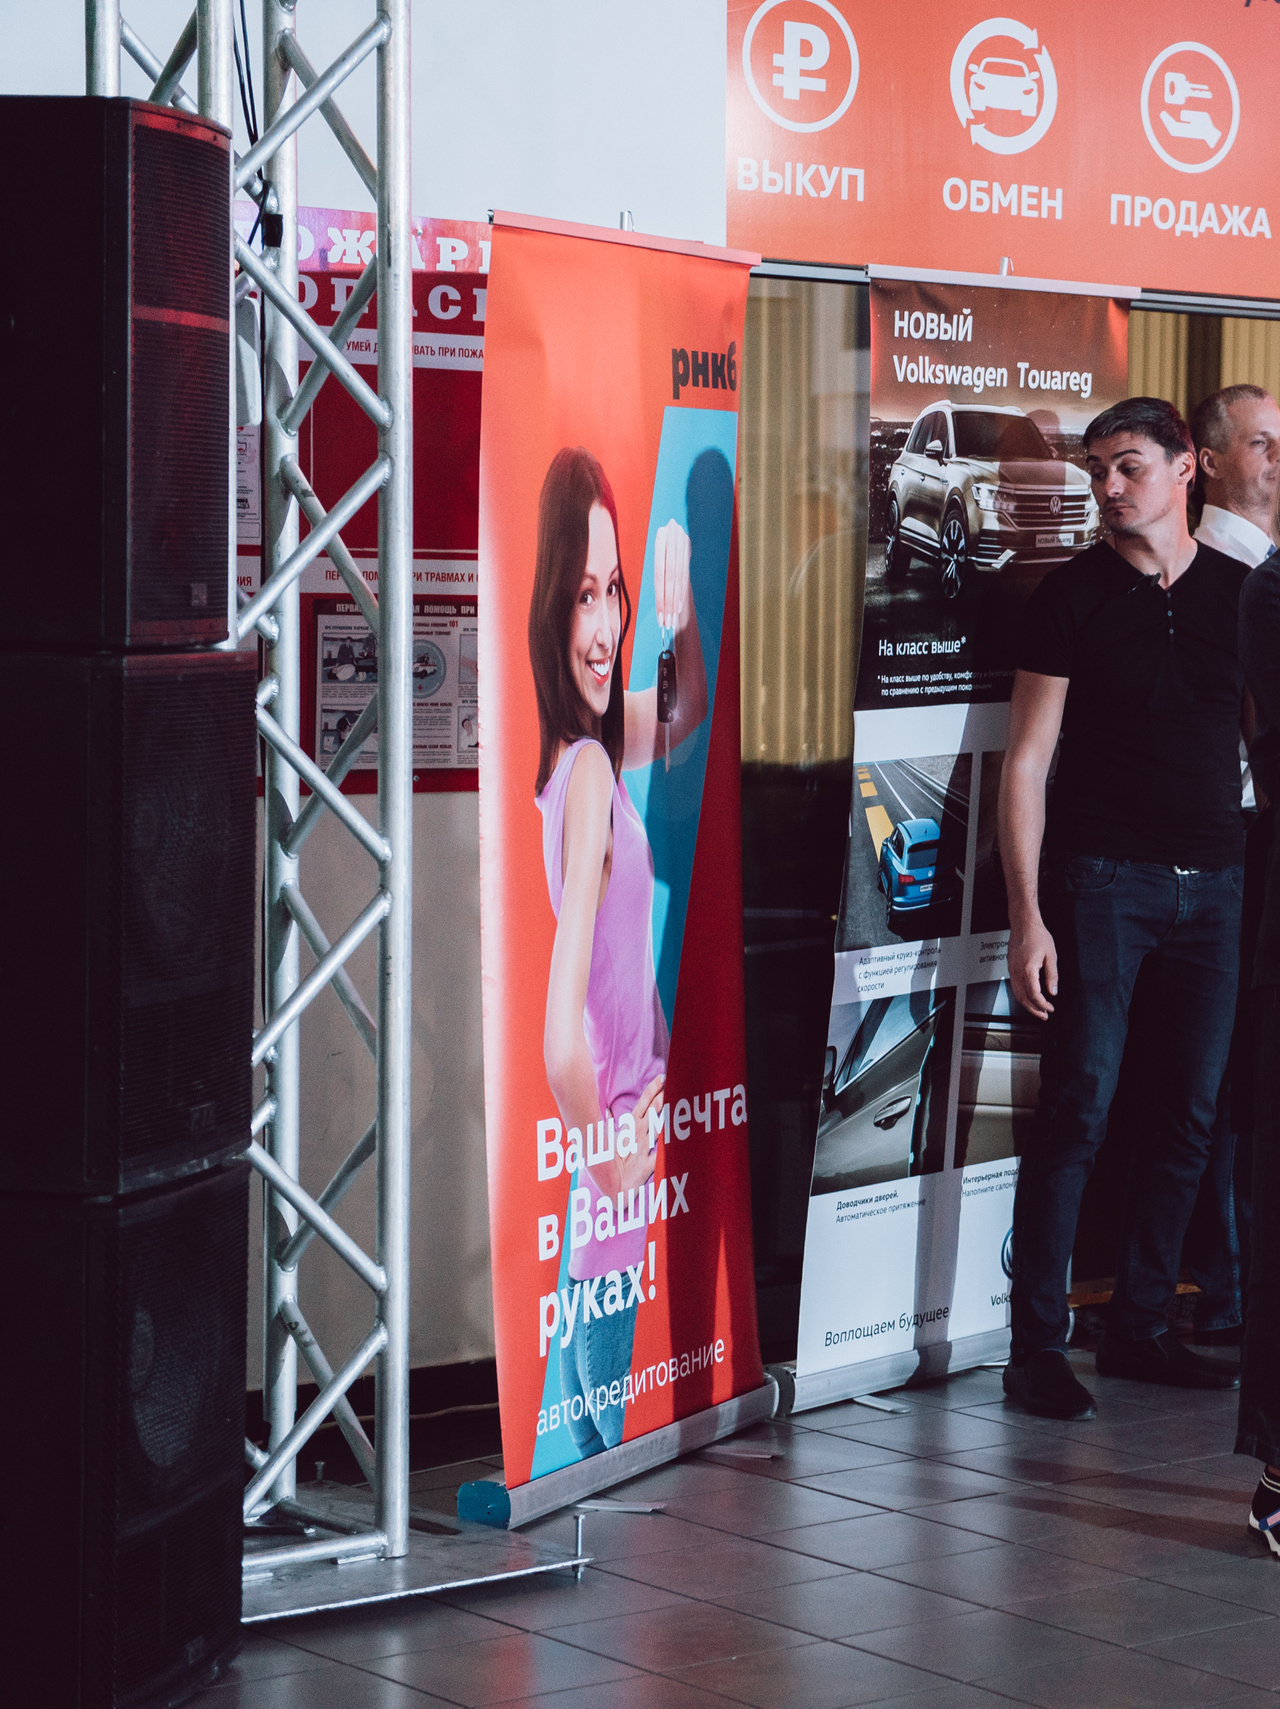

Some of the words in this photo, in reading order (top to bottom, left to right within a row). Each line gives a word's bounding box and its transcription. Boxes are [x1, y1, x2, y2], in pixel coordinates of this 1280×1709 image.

[736, 157, 865, 202] ВЫКУП
[942, 177, 1063, 220] ОБМЕН
[1110, 194, 1272, 240] ПРОДАЖА
[893, 308, 973, 342] НОВЫЙ
[346, 340, 371, 353] УМЕЙ
[438, 346, 456, 357] ПРИ
[458, 348, 484, 360] ПОЖА
[893, 355, 1008, 393] Volkswagen
[1017, 361, 1093, 399] Touareg
[425, 571, 466, 582] ТРАВМАХ
[424, 605, 457, 615] ПОМОЩЬ
[461, 606, 475, 614] ПРИ
[878, 639, 894, 657] На
[896, 640, 928, 656] класс
[890, 675, 905, 684] класс
[905, 674, 921, 683] выше
[921, 674, 929, 682] по
[881, 688, 889, 696] по
[859, 952, 896, 966] Адаптивный
[863, 965, 894, 980] функцией
[857, 982, 885, 993] скорости
[537, 1110, 638, 1182] Ваша
[648, 1083, 748, 1149] мечта
[962, 1171, 1003, 1185] Интерьерная
[836, 1197, 874, 1211] Доводчики
[874, 1190, 899, 1204] дверей.
[538, 1213, 559, 1261] в
[570, 1172, 689, 1251] Ваших
[836, 1206, 888, 1223] Автоматическое
[539, 1241, 657, 1357] руках!
[825, 1319, 896, 1347] Воплощаем
[899, 1305, 950, 1331] будущее
[537, 1337, 725, 1436] автокредитование
